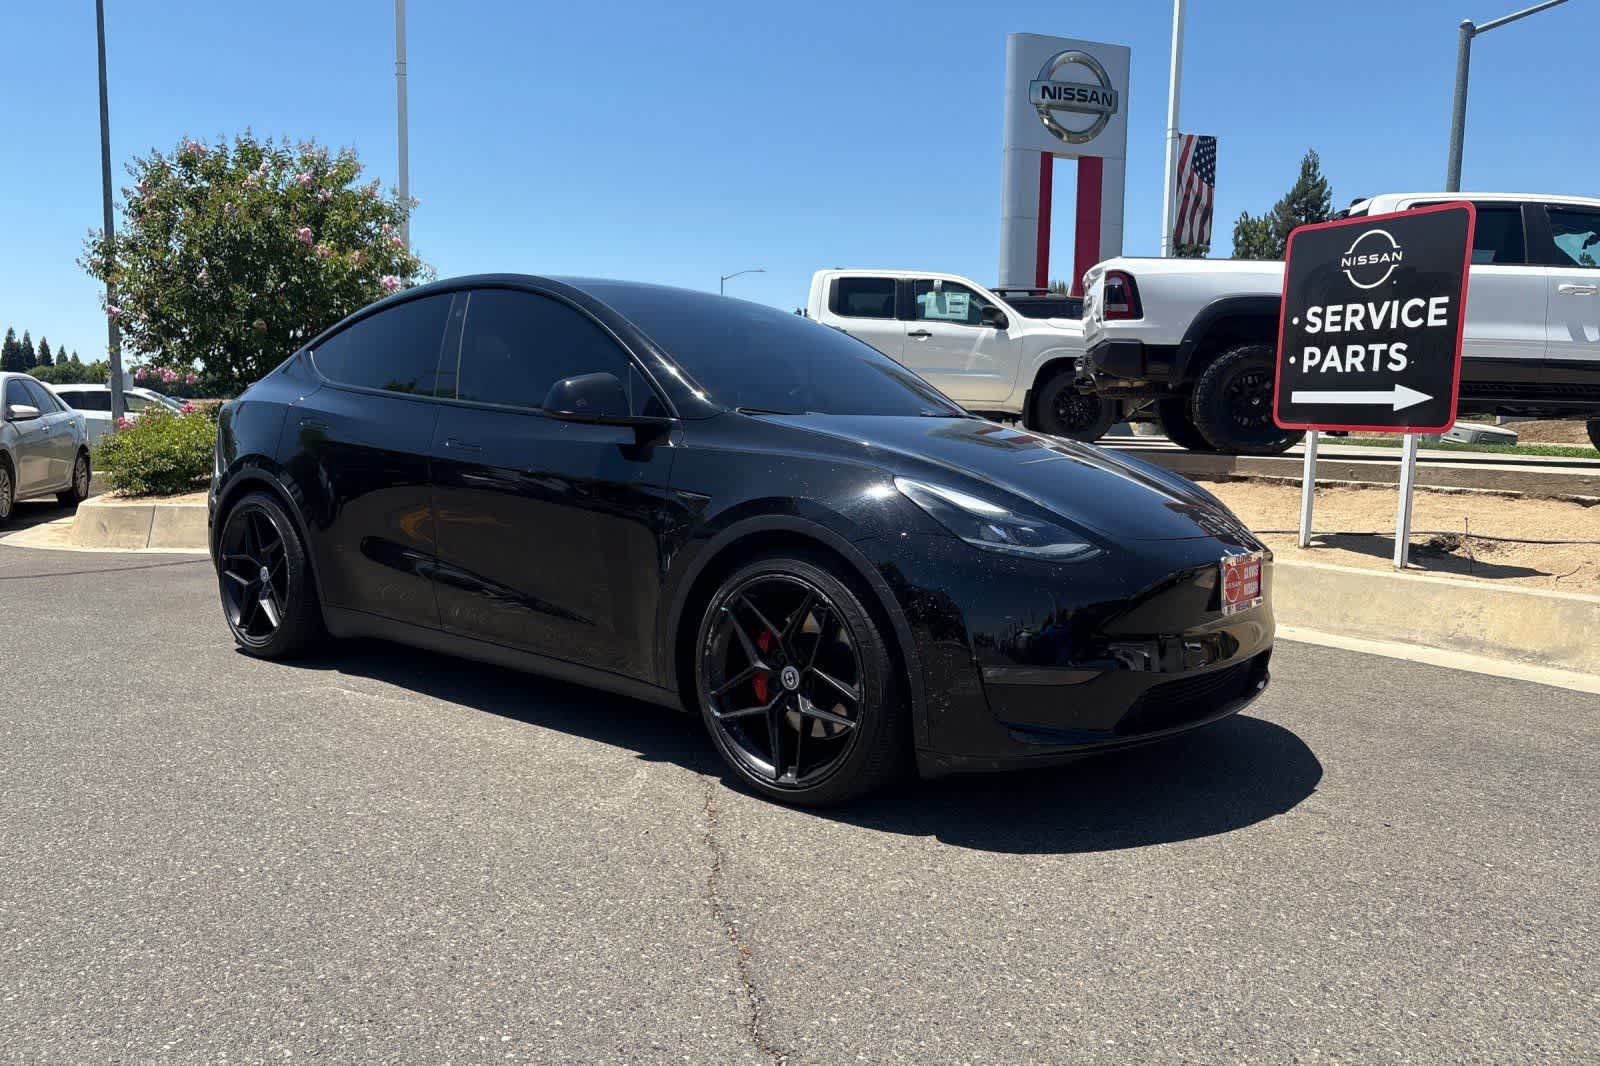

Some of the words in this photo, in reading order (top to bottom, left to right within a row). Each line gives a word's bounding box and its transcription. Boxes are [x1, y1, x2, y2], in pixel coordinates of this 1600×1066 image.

[1041, 85, 1113, 107] NISSAN
[1341, 251, 1403, 267] NISSAN
[1304, 296, 1450, 334] SERVICE
[1302, 342, 1408, 373] PARTS
